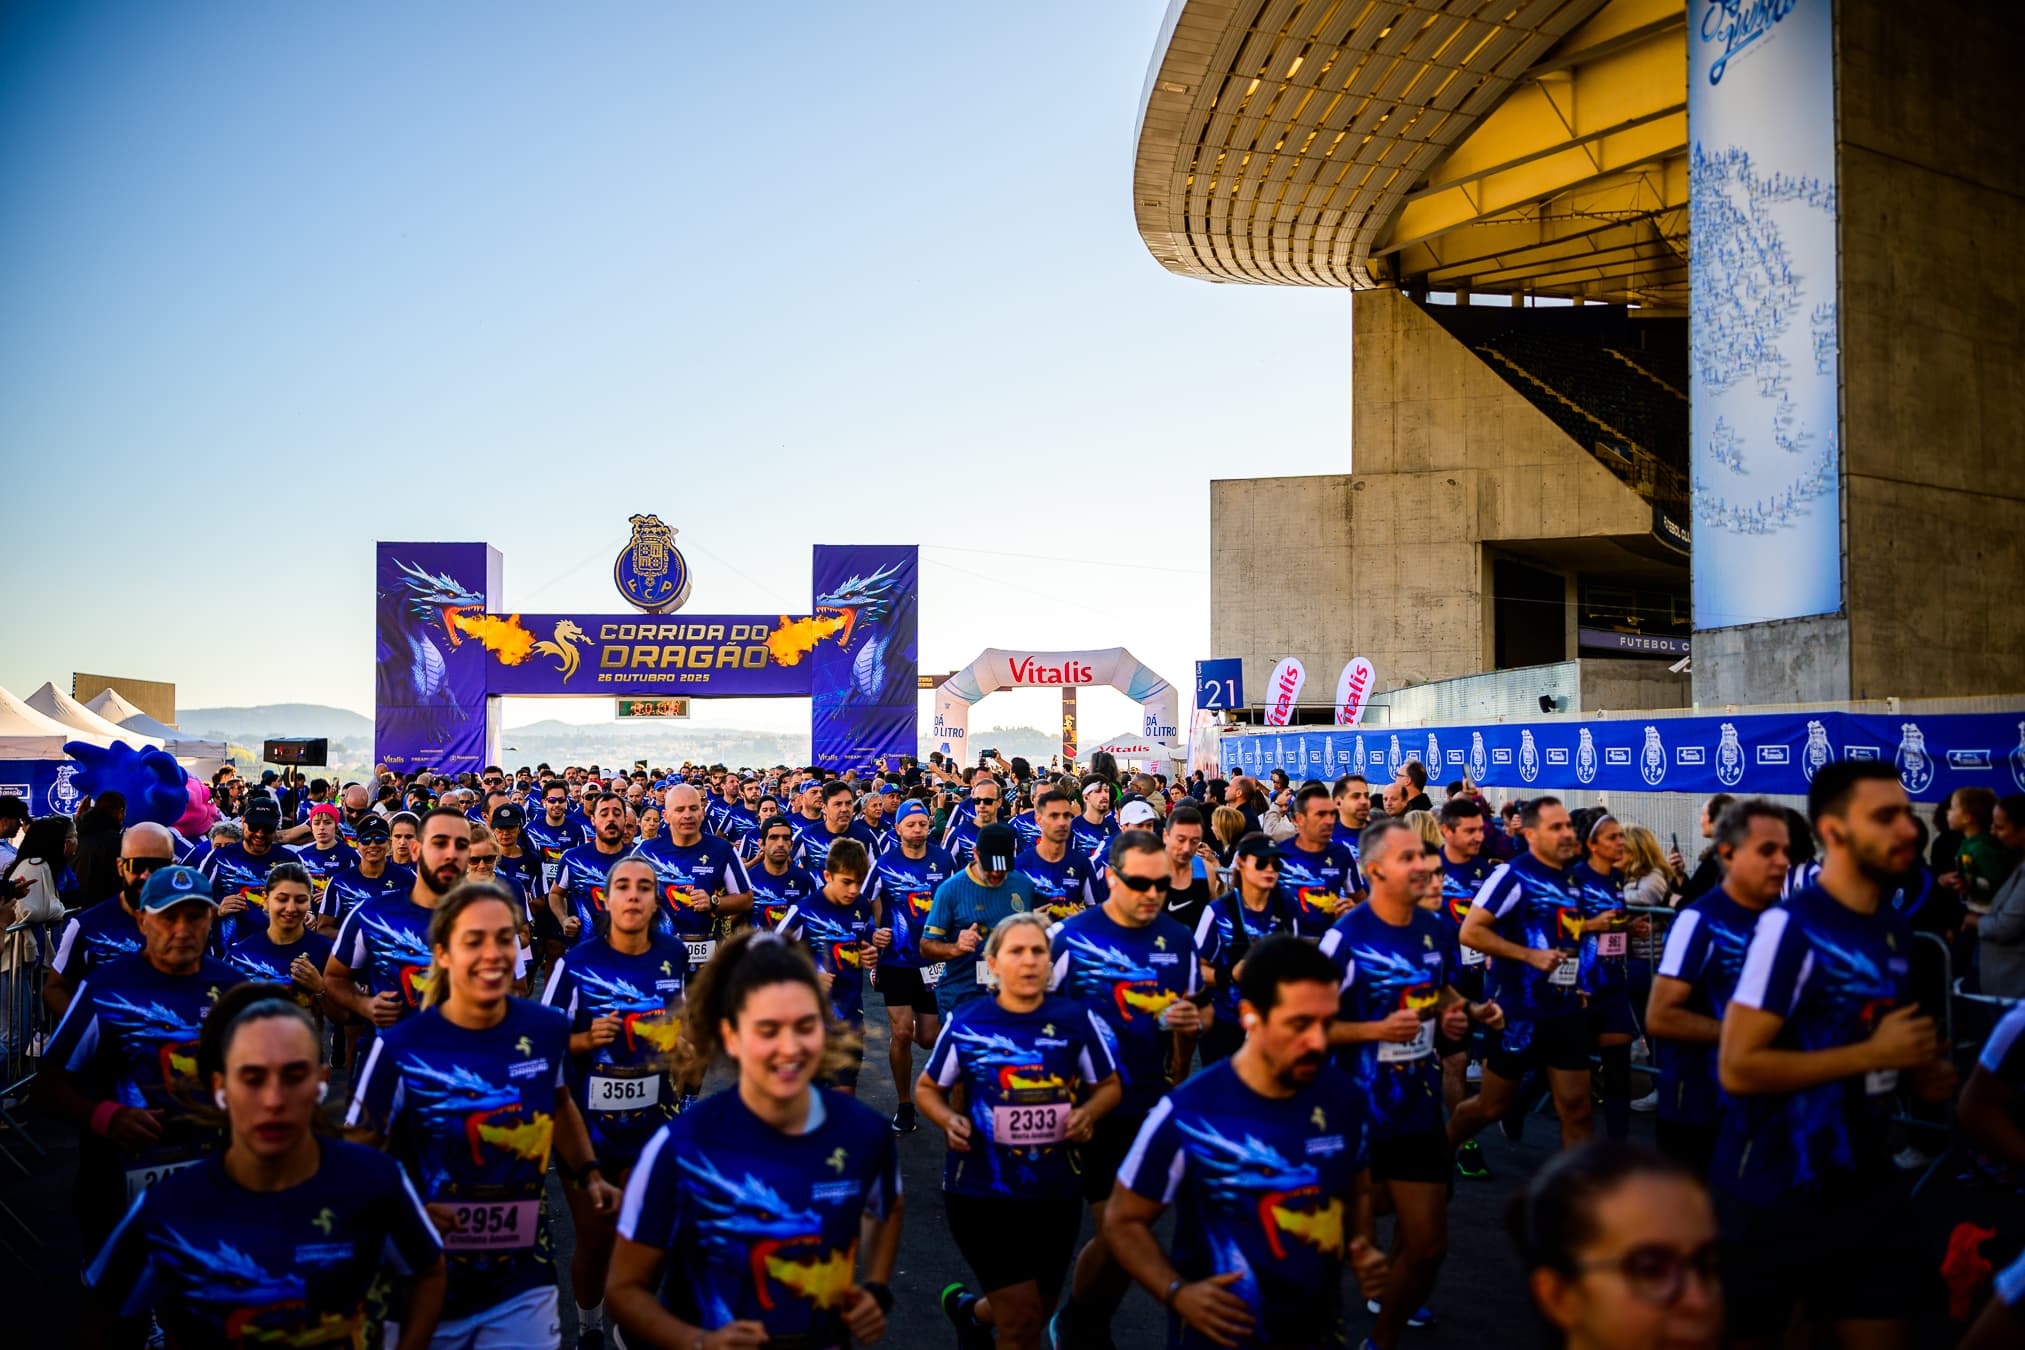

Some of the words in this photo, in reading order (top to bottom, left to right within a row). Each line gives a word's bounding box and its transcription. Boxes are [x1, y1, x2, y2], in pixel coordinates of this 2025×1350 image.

[600, 624, 725, 640] CORRIDA
[730, 625, 769, 640] DO
[1620, 636, 1676, 651] FUTEBOL
[600, 641, 770, 669] DRAGÃO
[1008, 655, 1093, 684] Vitalis
[598, 673, 612, 682] 26
[614, 673, 675, 682] OUTUBRO
[679, 673, 710, 682] 2025
[1204, 679, 1236, 707] 21
[1146, 713, 1158, 726] DÁ
[940, 727, 965, 738] LITRO
[1145, 726, 1151, 737] O
[1153, 726, 1177, 737] LITRO
[1098, 744, 1150, 753] Vitalis
[383, 755, 404, 763] Vitalis
[603, 1081, 646, 1099] 3561
[1010, 1108, 1056, 1131] 2333
[457, 1205, 518, 1233] 2954
